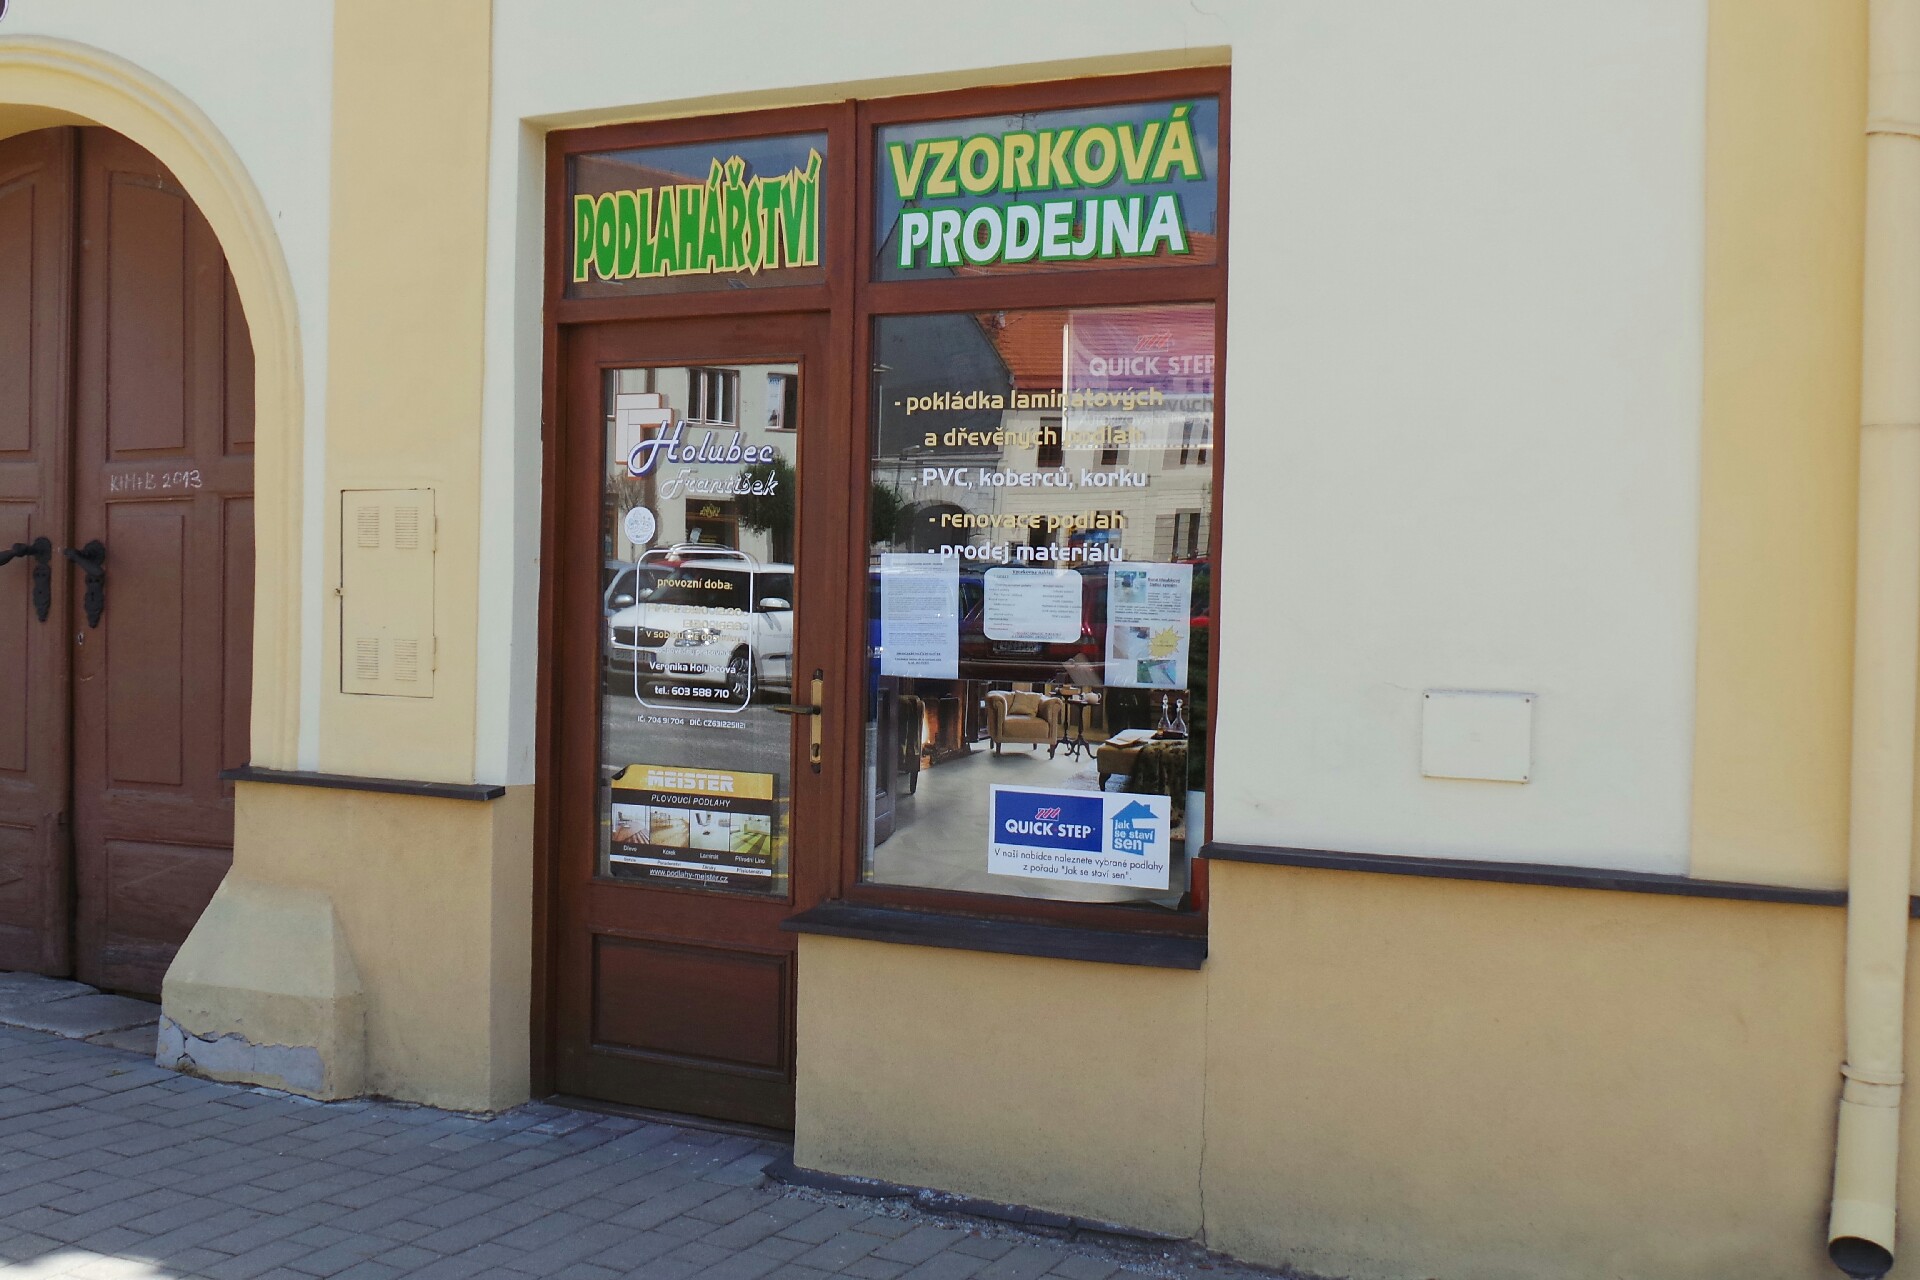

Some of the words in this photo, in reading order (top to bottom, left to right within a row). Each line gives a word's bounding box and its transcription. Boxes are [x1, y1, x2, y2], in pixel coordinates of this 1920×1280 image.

[887, 102, 1202, 199] VZORKOVÁ
[573, 147, 822, 282] PODLAHÁŘSTVÍ
[898, 194, 1191, 269] PRODEJNA
[1089, 356, 1160, 376] QUICK
[906, 390, 1004, 415] pokládka
[1010, 387, 1163, 411] laminátových
[628, 420, 773, 477] Holubec
[924, 431, 937, 446] a
[944, 426, 1057, 450] dřevěných
[162, 469, 202, 488] 2013
[660, 468, 779, 499] František
[922, 468, 973, 490] PVC,
[979, 466, 1073, 490] koberců,
[1080, 468, 1146, 487] korku
[941, 513, 1040, 529] renovace
[1048, 511, 1125, 533] podlah
[940, 543, 1010, 564] prodej
[1016, 542, 1123, 562] materiálu
[657, 578, 701, 588] provozní
[705, 579, 733, 590] doba:
[650, 661, 688, 671] Veronika
[690, 662, 736, 674] Holubcová
[671, 687, 690, 696] 603
[692, 688, 712, 697] 588
[714, 688, 730, 698] 710
[647, 769, 734, 792] MEISTER
[651, 794, 691, 804] PLOVOUCÍ
[693, 797, 730, 807] PODLAHY
[1005, 818, 1053, 836] QUICK
[1058, 824, 1091, 839] STEP
[1114, 830, 1126, 838] se
[1129, 830, 1153, 840] staví
[1114, 838, 1143, 851] sen
[994, 848, 1001, 856] V
[1002, 849, 1018, 858] naší
[1021, 850, 1052, 861] nabídce
[1054, 854, 1092, 865] naleznete
[1094, 857, 1127, 868] vybrané
[1130, 860, 1163, 873] podlahy
[1030, 863, 1058, 874] pořadu
[1080, 868, 1089, 876] se
[1091, 868, 1109, 878] staví
